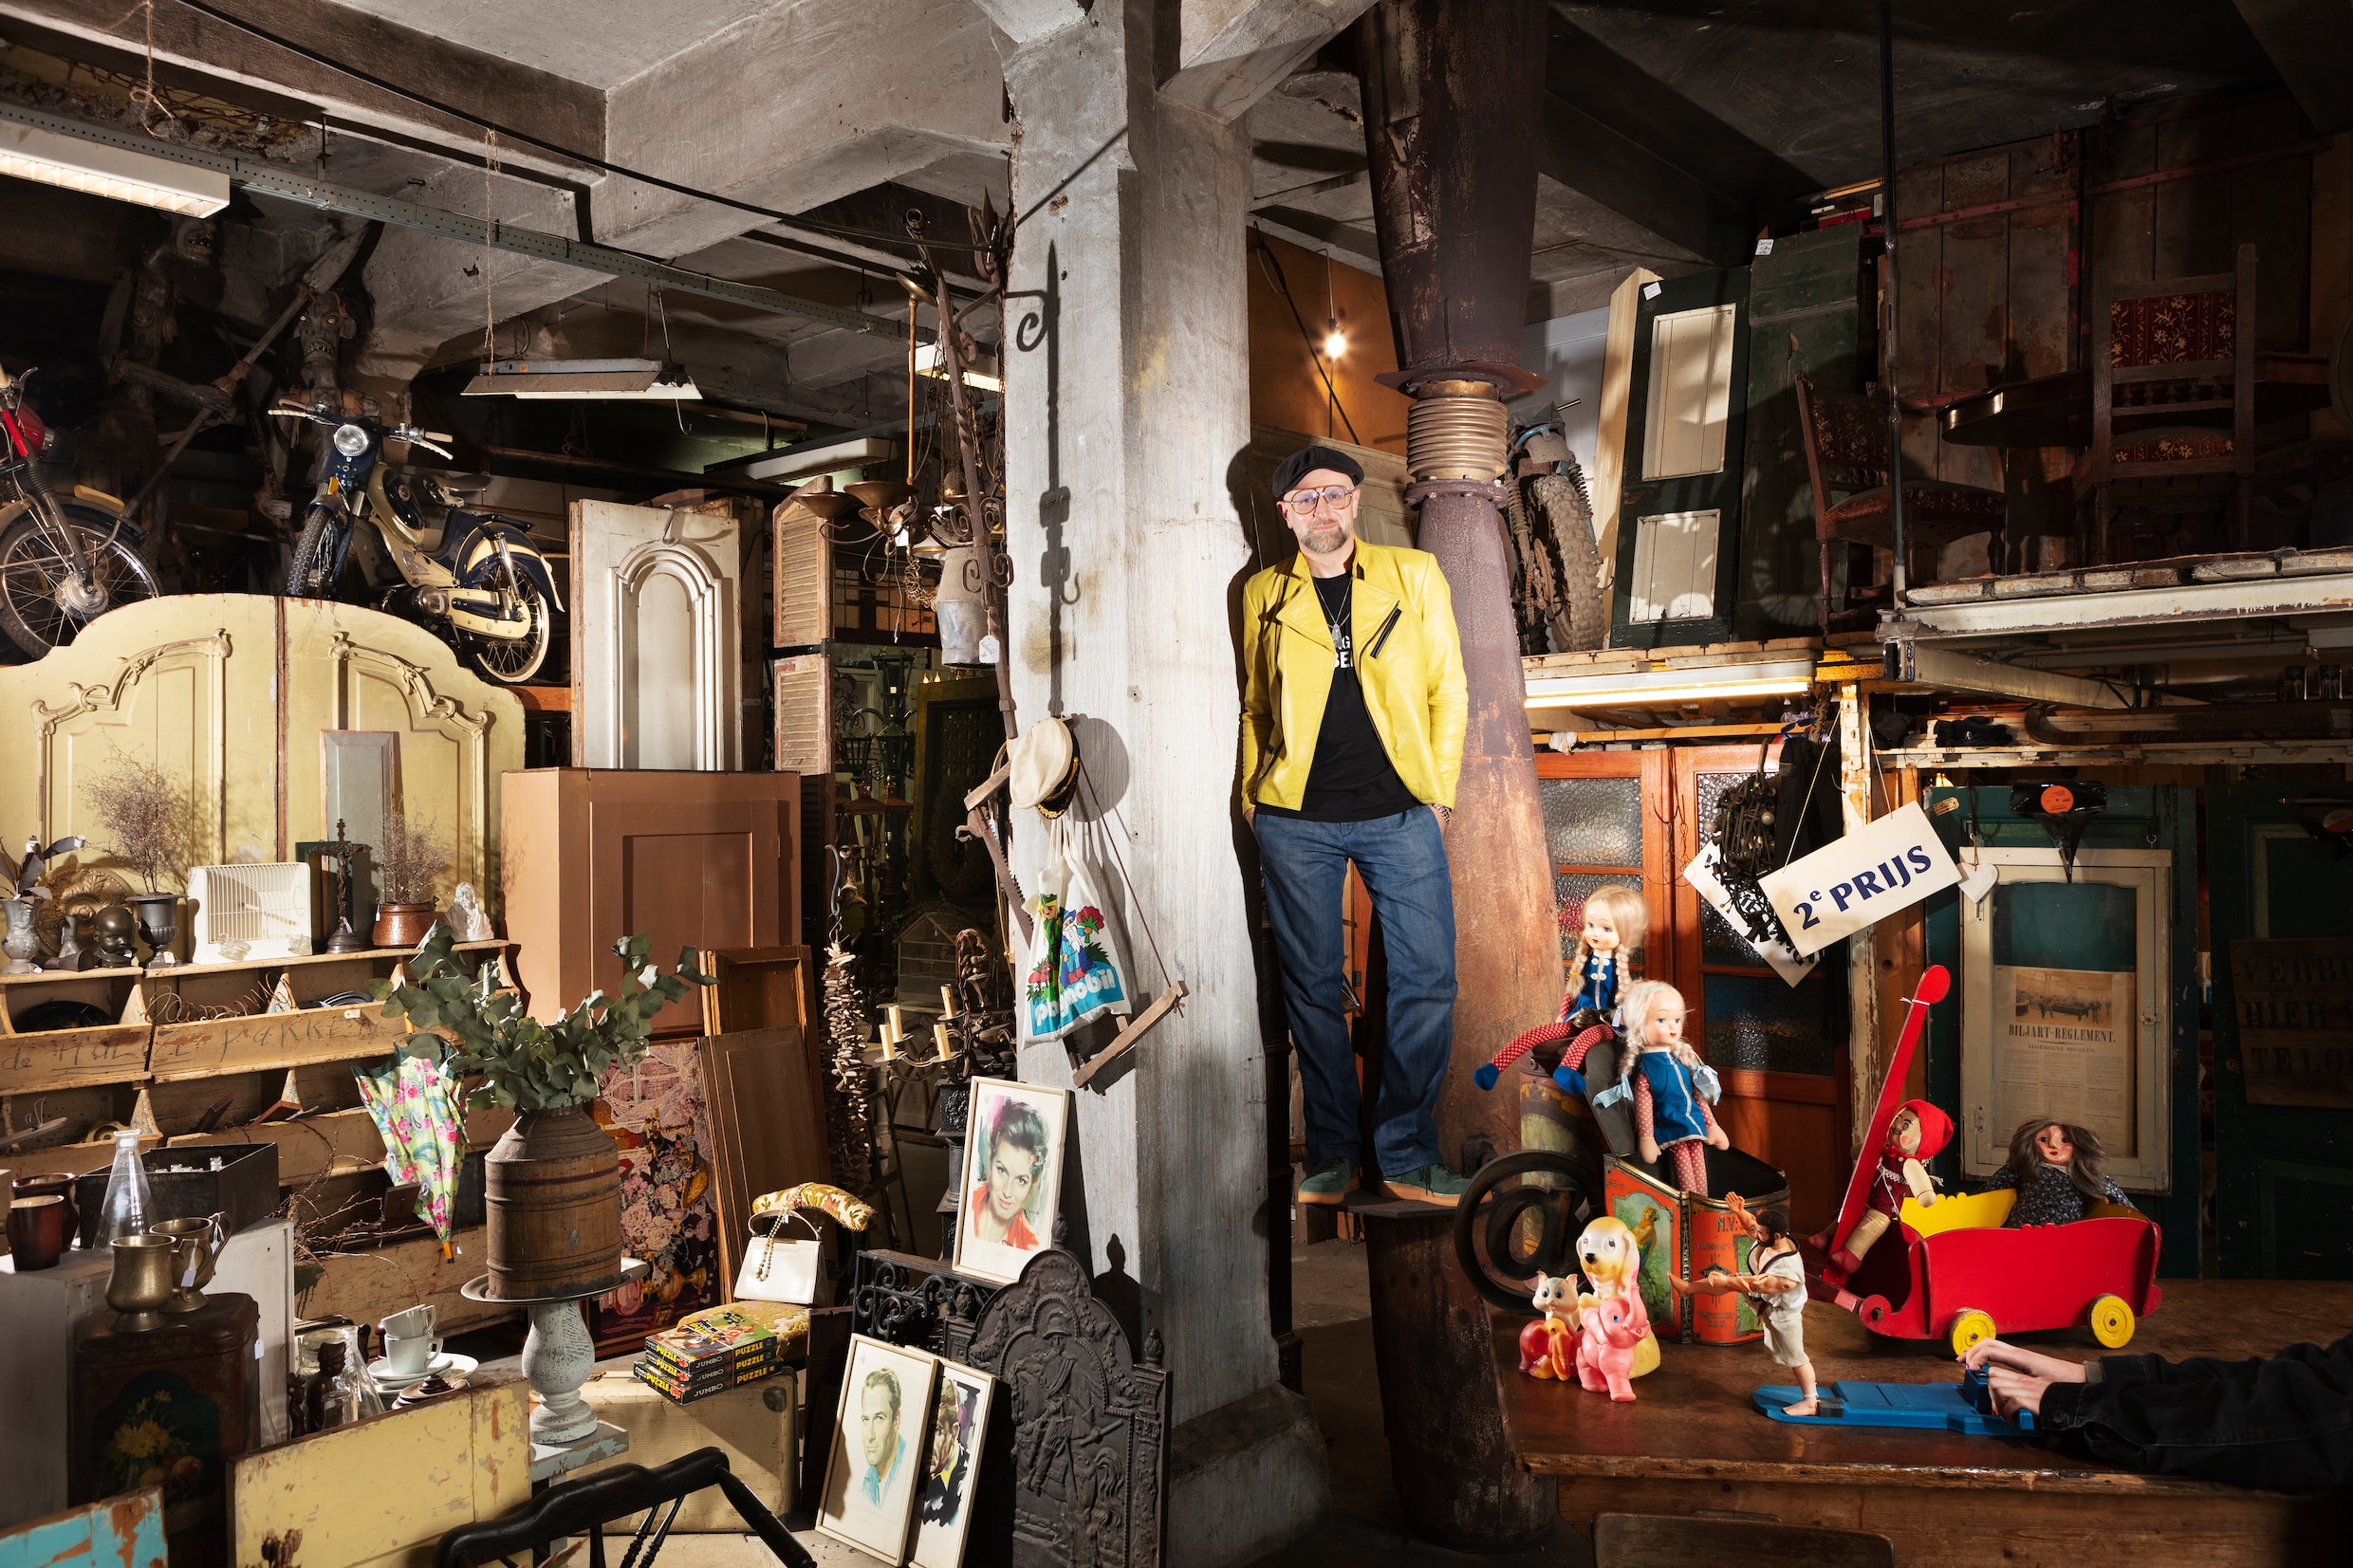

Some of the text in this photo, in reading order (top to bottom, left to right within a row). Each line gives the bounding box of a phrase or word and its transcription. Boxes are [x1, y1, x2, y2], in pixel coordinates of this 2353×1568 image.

[1829, 845, 1932, 913] PRIJS
[1034, 968, 1117, 1027] playmobil
[2009, 1024, 2117, 1042] BILJART-REGLEMENT.
[656, 1344, 677, 1363] PUZZLE
[656, 1358, 678, 1377] PUZZLE
[695, 1340, 764, 1369] JUMBO PUZZLE
[694, 1383, 724, 1397] JUMBO
[736, 1367, 768, 1384] PUZZLE
[696, 1368, 724, 1382] JUMBO
[735, 1354, 765, 1370] PUZZLE
[646, 1372, 670, 1393] PUZZLE
